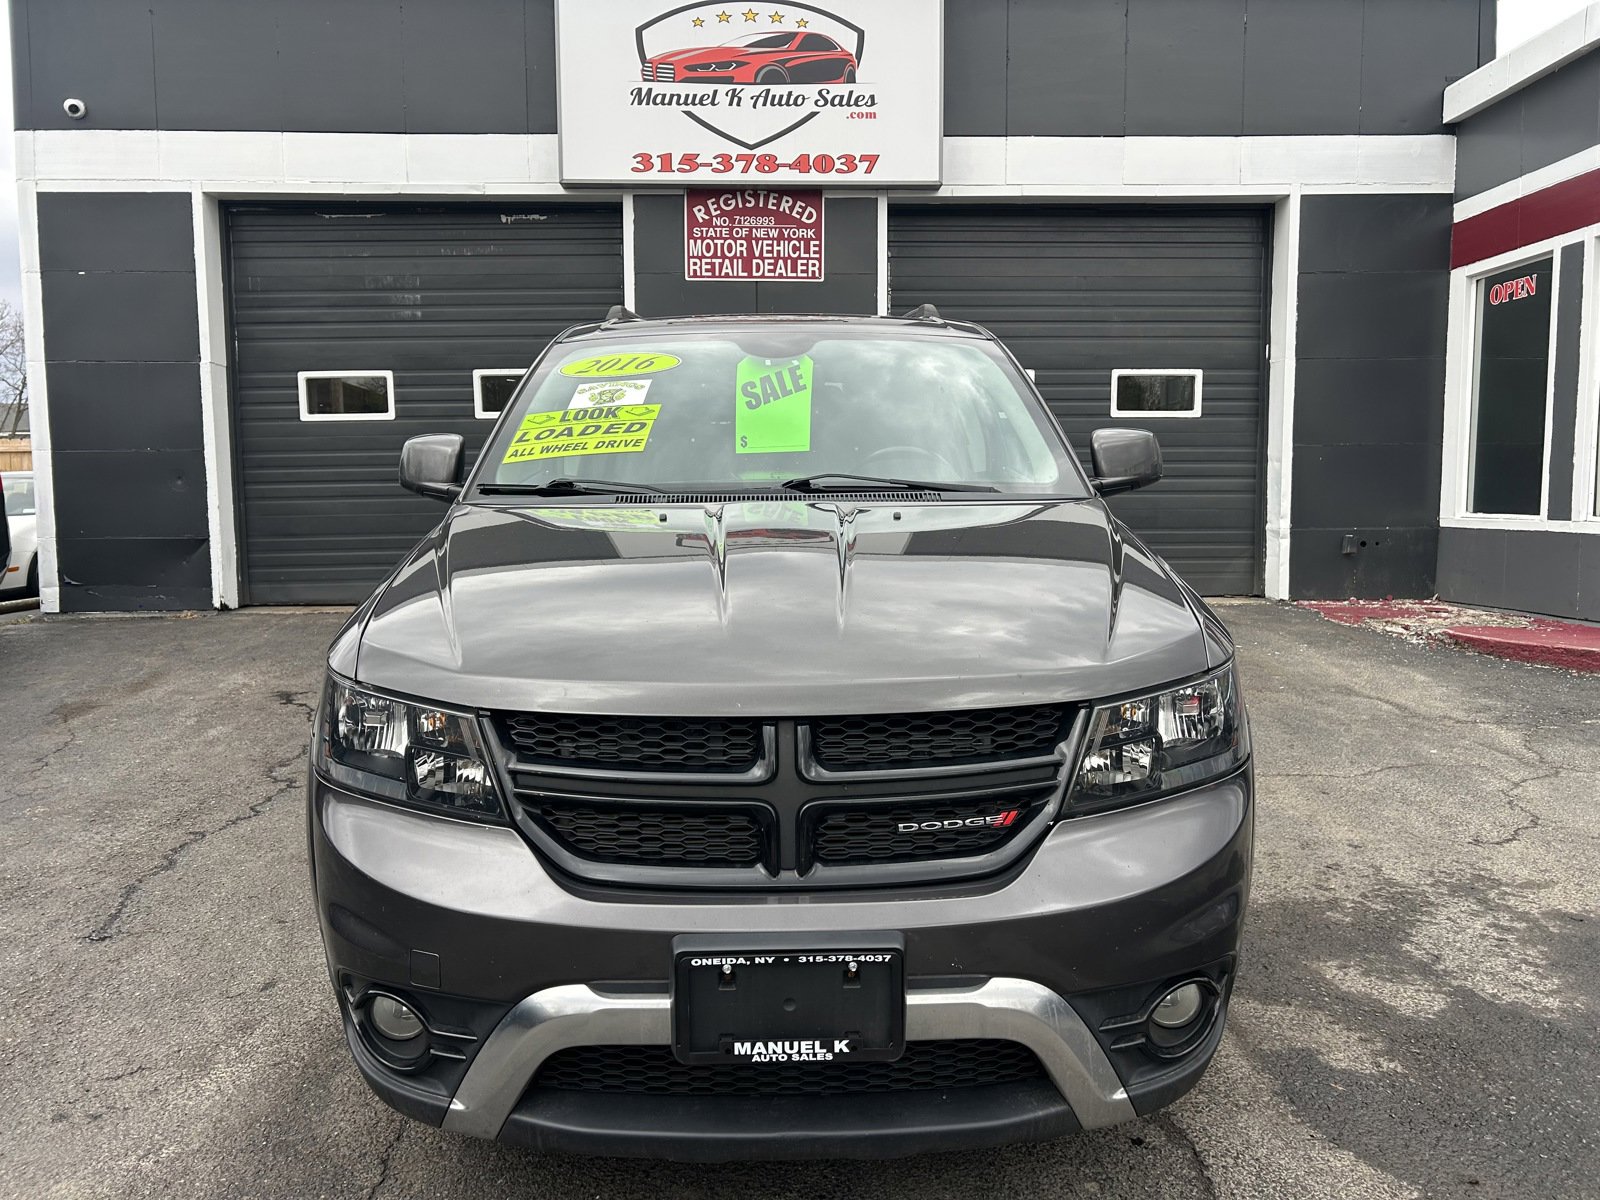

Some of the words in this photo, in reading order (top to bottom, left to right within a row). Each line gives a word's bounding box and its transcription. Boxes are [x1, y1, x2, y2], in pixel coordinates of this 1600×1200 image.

[630, 87, 720, 106] Manuel
[725, 88, 746, 107] K
[750, 88, 810, 109] Auto
[814, 88, 878, 108] Sales
[846, 110, 877, 120] .com
[630, 152, 880, 174] 315-378-4037
[692, 190, 817, 224] REGISTERED
[712, 217, 732, 227] NO.
[733, 216, 775, 225] 7126993
[693, 228, 730, 238] STATE
[733, 228, 749, 238] OF
[752, 228, 779, 238] NEW
[782, 229, 816, 239] YORK
[689, 239, 747, 257] MOTOR
[752, 240, 820, 258] VEHICLE
[689, 259, 748, 276] RETAIL
[752, 259, 820, 277] DEALER
[1490, 273, 1537, 305] OPEN
[574, 356, 663, 375] 2016
[741, 365, 807, 410] SALE
[558, 406, 622, 423] LOOK
[514, 421, 648, 444] LOADED
[740, 435, 748, 448] $
[507, 447, 535, 459] ALL
[539, 441, 588, 454] WHEEL
[594, 438, 644, 450] DRIVE
[898, 815, 1004, 832] DODGE
[691, 957, 751, 966] ONEIDA,
[754, 956, 776, 964] NY
[798, 954, 892, 963] 315-378-4037
[733, 1040, 827, 1056] MANUEL
[833, 1039, 850, 1053] K
[751, 1053, 788, 1063] AUTO
[791, 1052, 834, 1062] SALES
